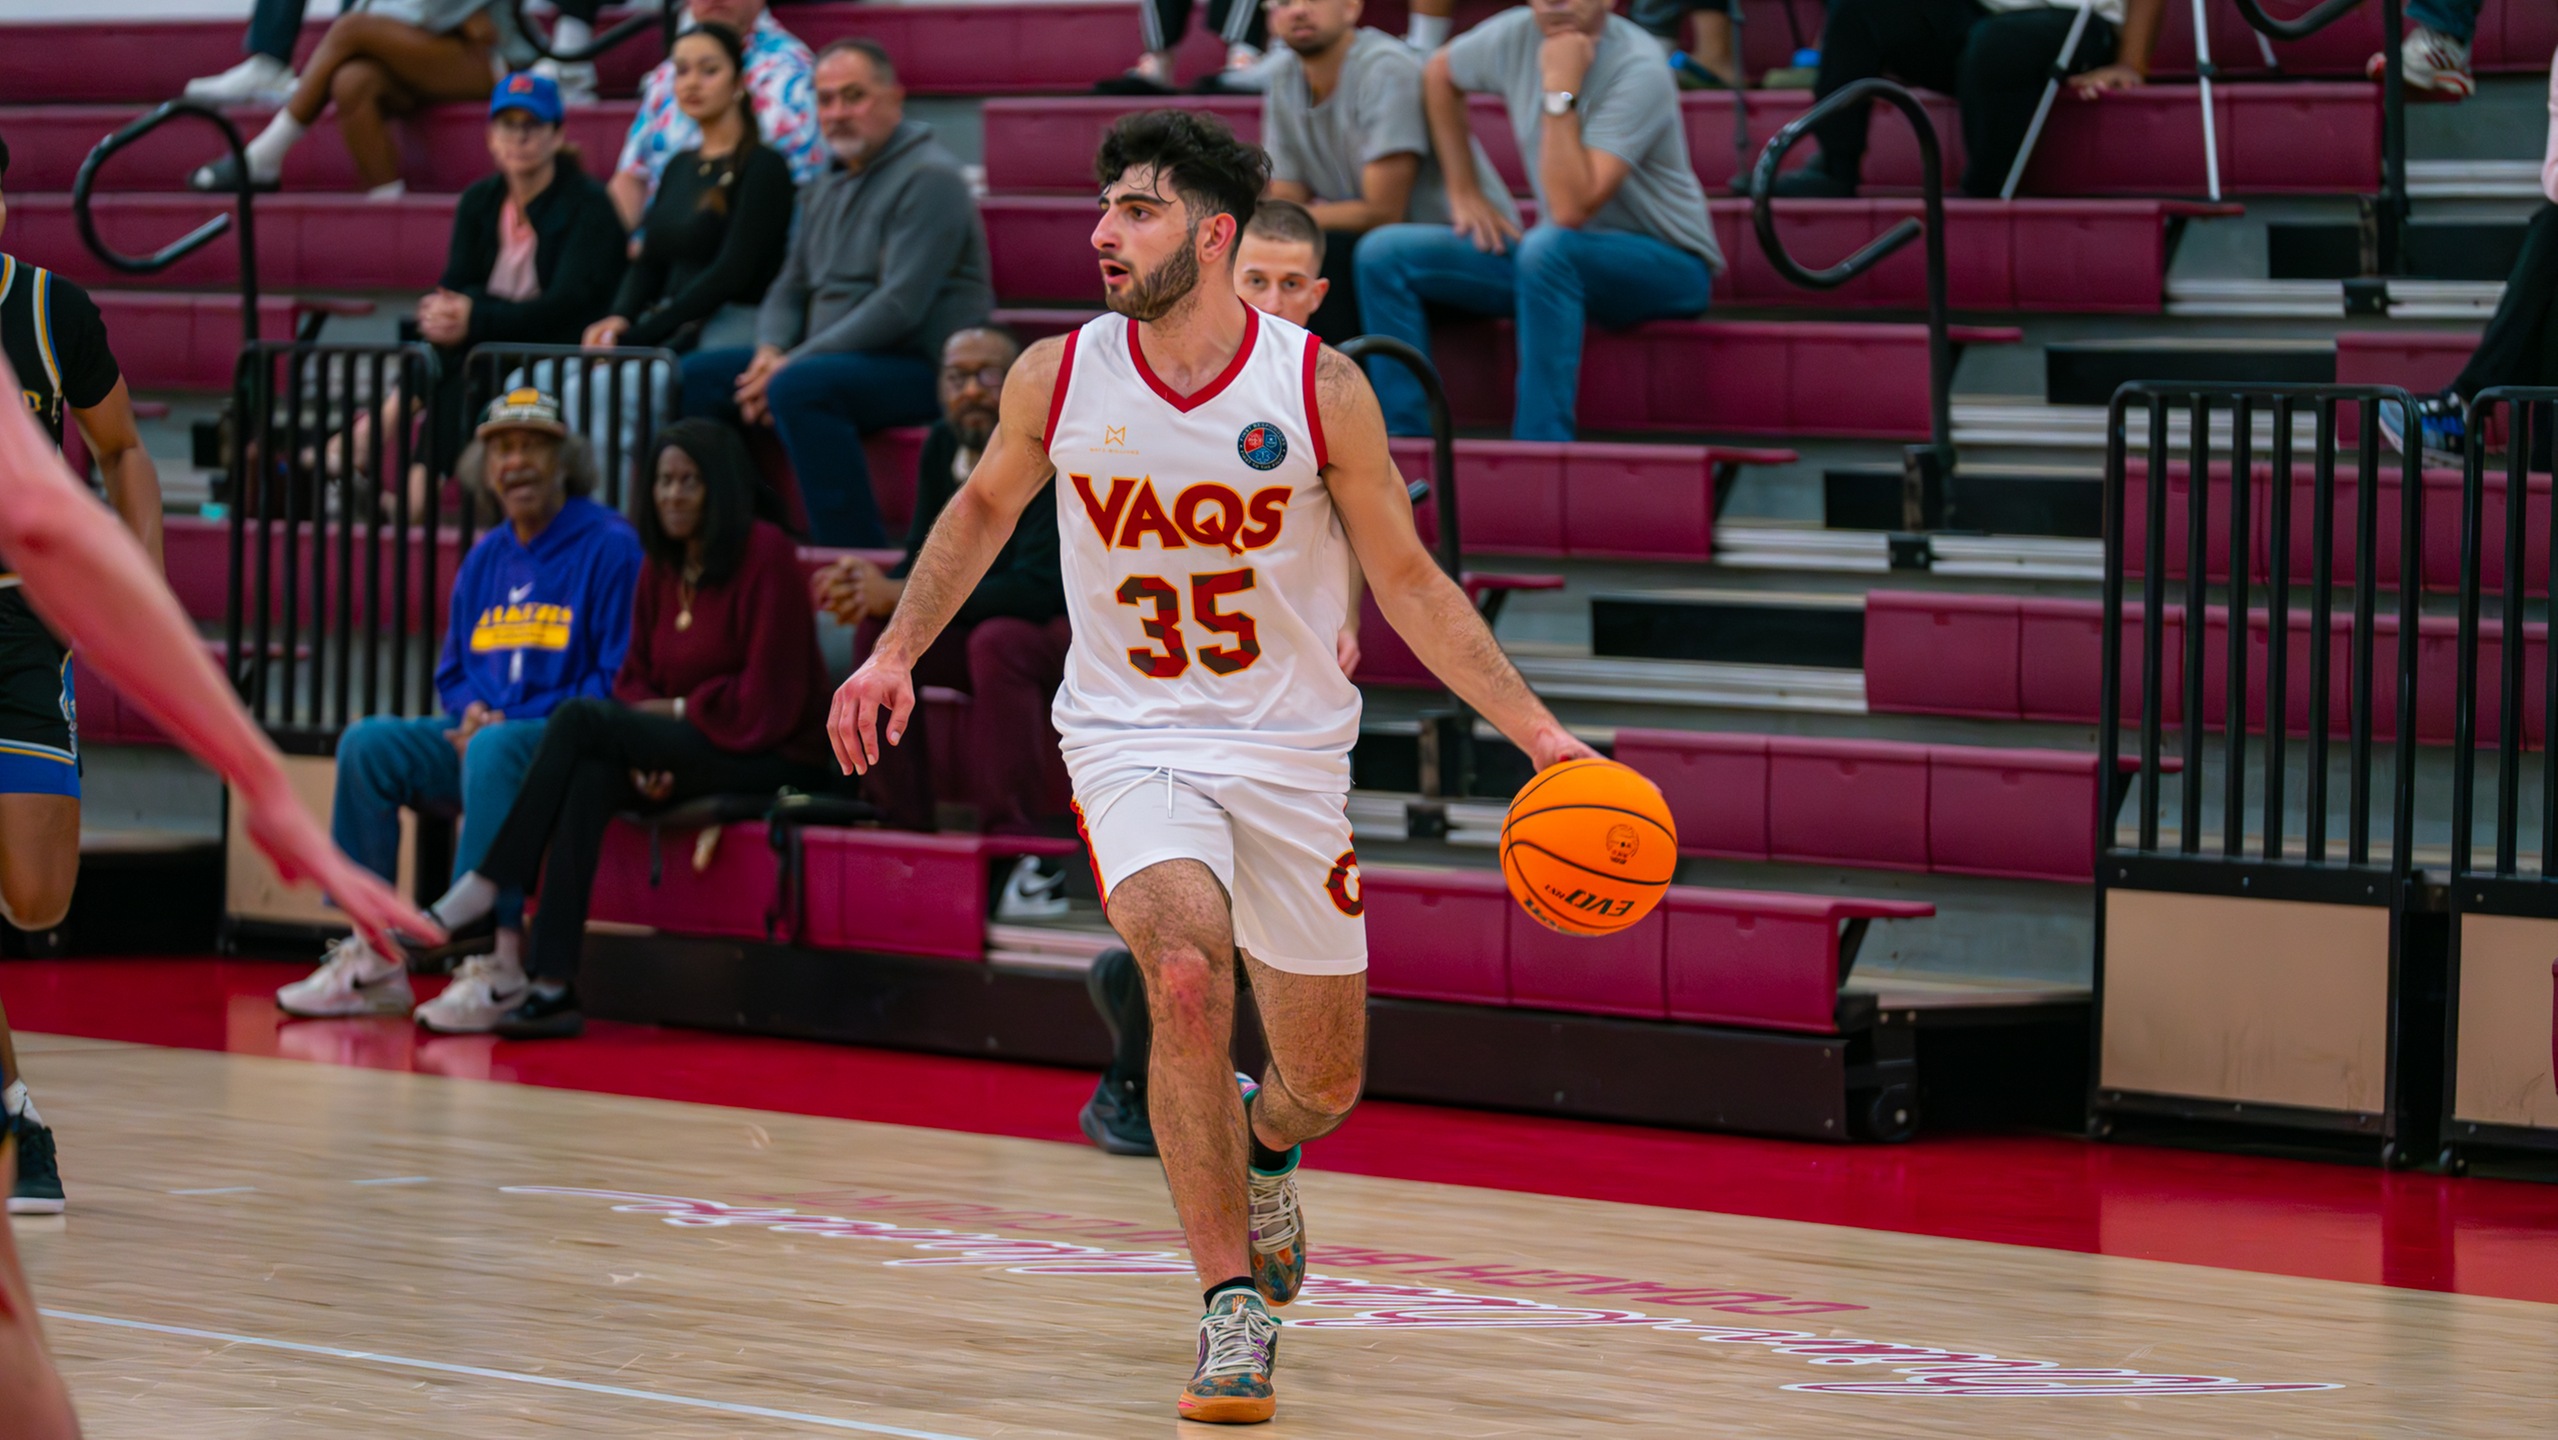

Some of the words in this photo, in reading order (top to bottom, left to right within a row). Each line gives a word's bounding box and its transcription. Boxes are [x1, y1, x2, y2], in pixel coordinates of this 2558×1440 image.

[1069, 473, 1294, 557] VAQS
[1115, 567, 1262, 679] 35
[1565, 889, 1635, 917] EVO
[721, 1189, 1138, 1232] COURT
[1394, 1263, 1869, 1316] COACH
[1651, 1325, 2345, 1398] Brian
